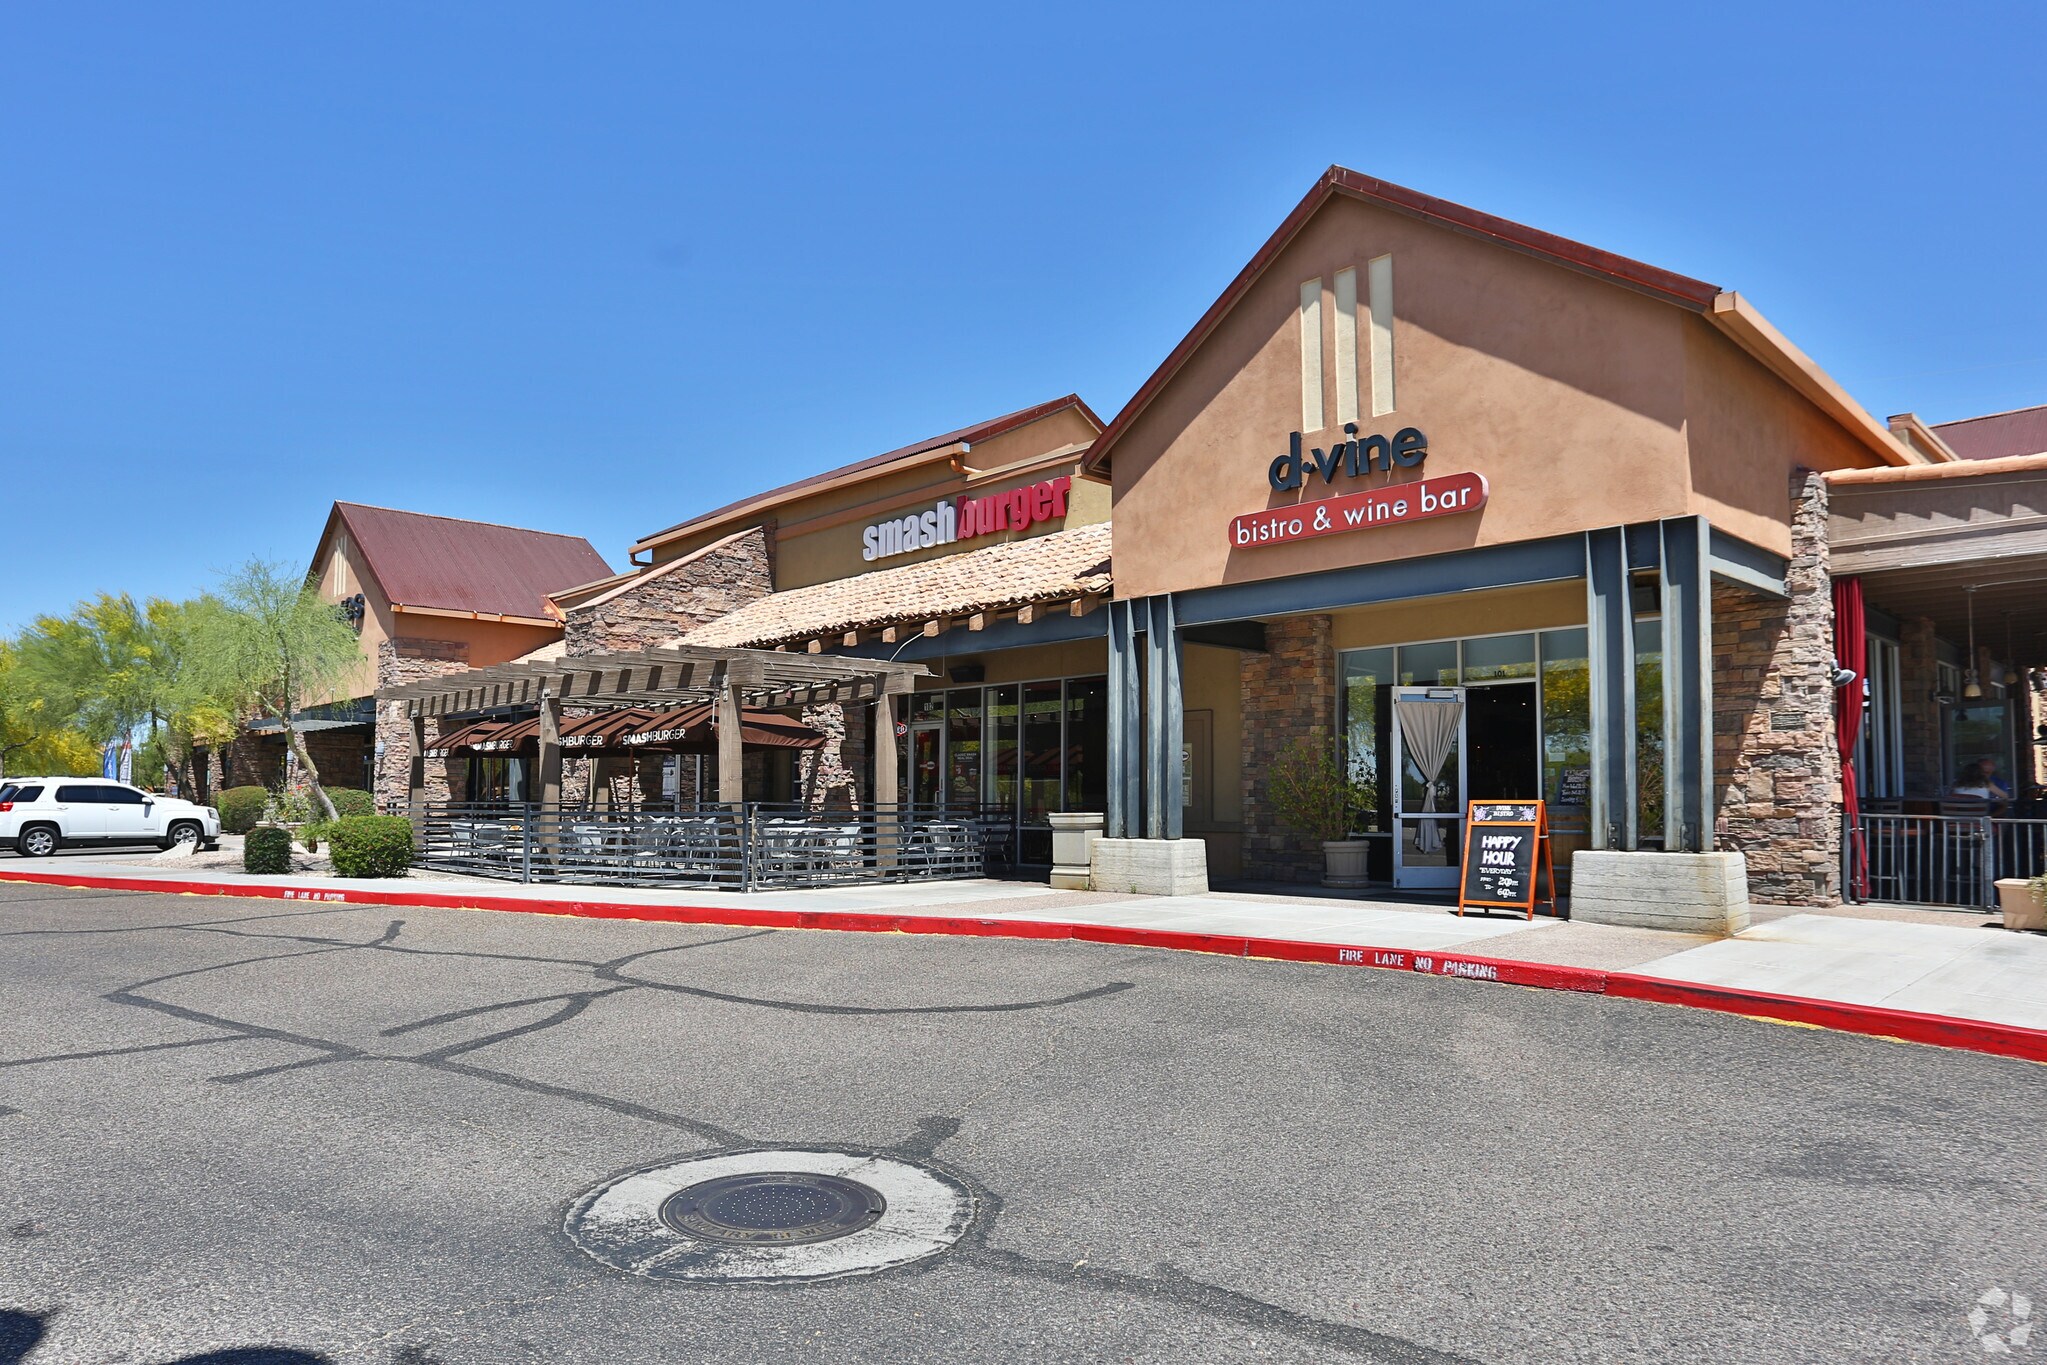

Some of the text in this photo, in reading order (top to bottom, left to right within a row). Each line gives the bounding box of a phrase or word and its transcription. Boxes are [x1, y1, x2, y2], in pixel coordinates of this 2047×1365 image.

[862, 475, 1071, 562] smashburger
[1236, 484, 1471, 545] bistro & wine bar
[622, 728, 686, 745] SMASHBURGER
[1481, 835, 1522, 850] HAPPY
[1481, 850, 1516, 866] HOUR
[1339, 948, 1497, 979] FIRE LANE NO PARKING
